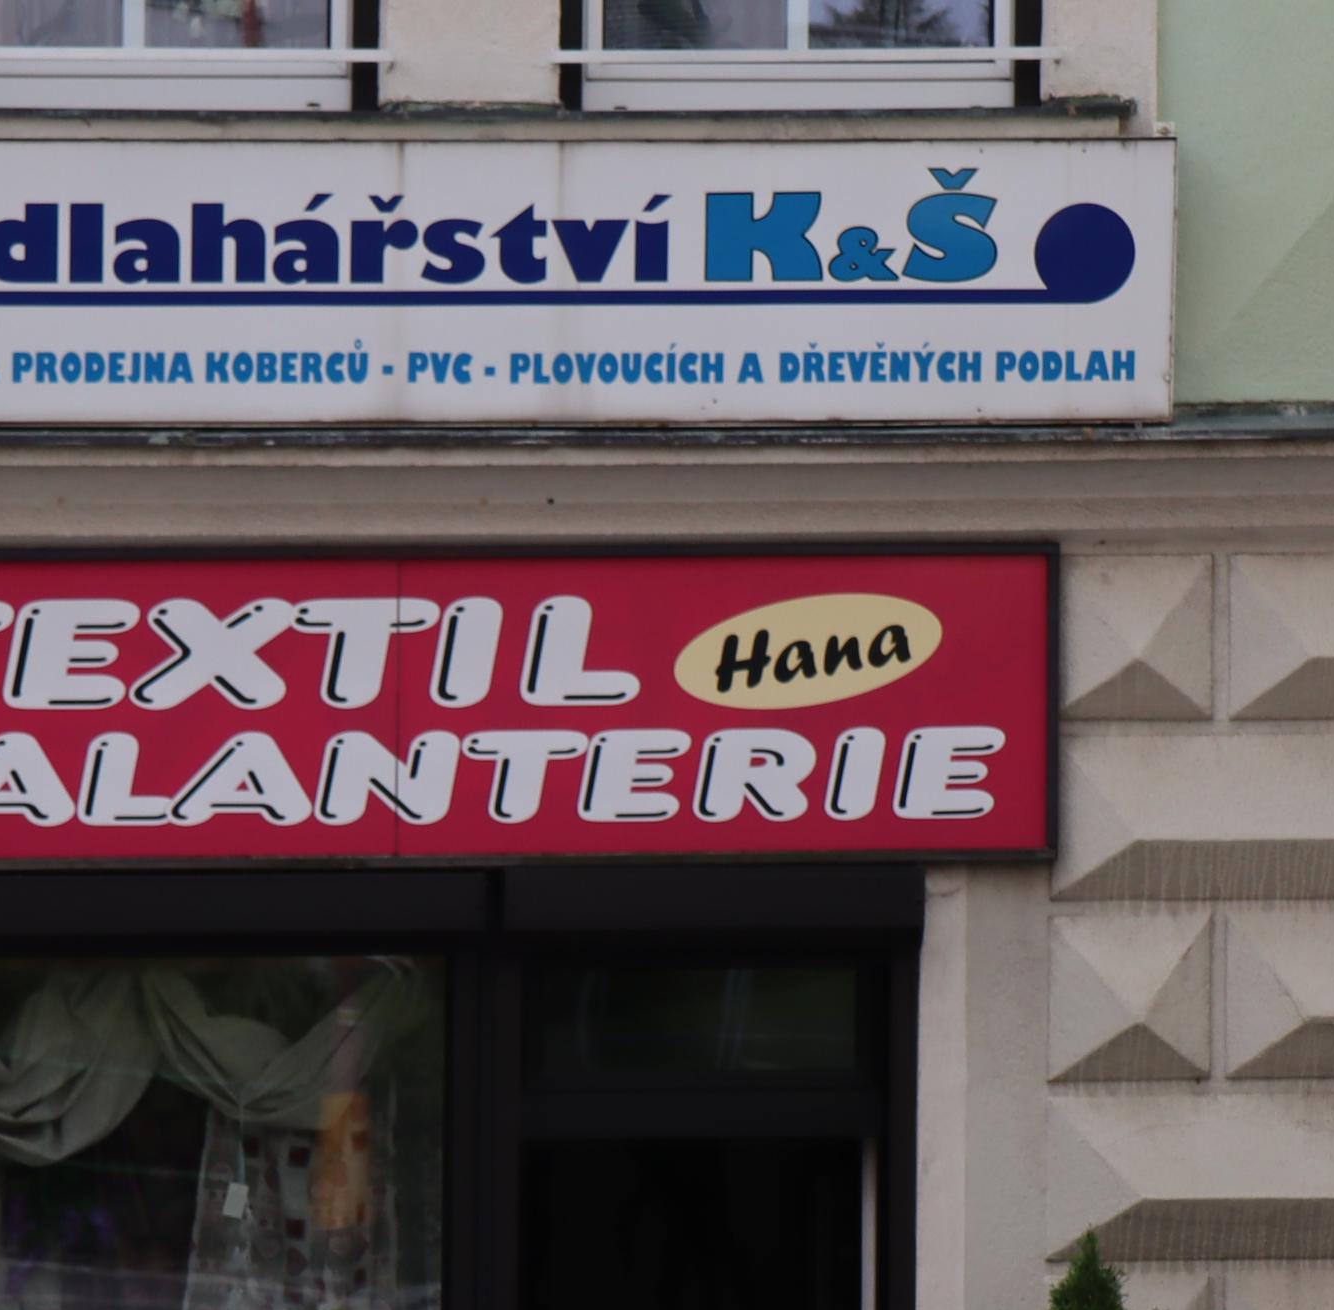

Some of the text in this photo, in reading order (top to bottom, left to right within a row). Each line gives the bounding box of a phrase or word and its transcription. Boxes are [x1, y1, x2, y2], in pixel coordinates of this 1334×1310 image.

[13, 352, 193, 383] PRODEJNA
[206, 339, 369, 384] KOBERCŮ
[408, 353, 473, 384] PVC
[510, 342, 724, 384] PLOVOUCÍCH
[738, 351, 764, 383] A
[779, 341, 982, 383] DŘEVĚNÝCH
[996, 350, 1136, 382] PODLAH
[715, 624, 912, 693] Hana
